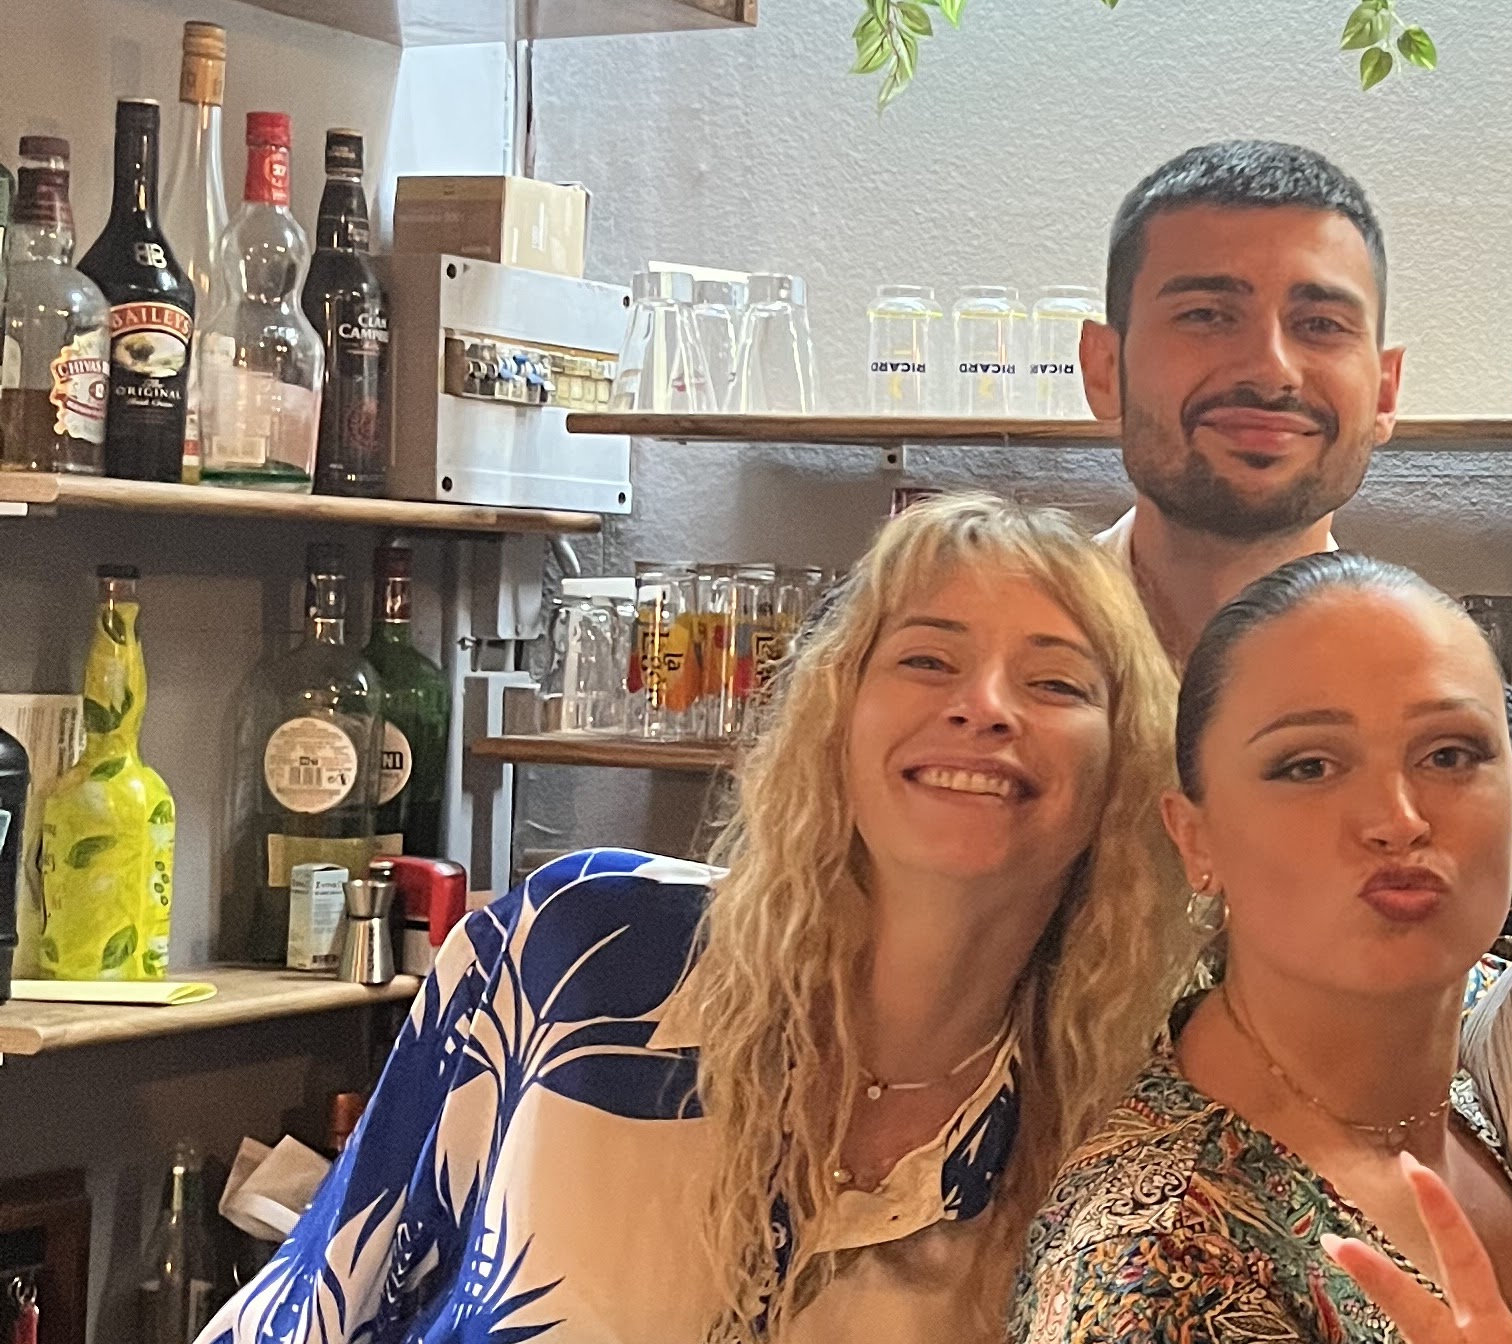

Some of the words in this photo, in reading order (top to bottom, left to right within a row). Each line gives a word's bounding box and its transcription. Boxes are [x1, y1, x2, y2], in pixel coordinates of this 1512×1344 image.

[111, 308, 191, 334] BAILEYS
[57, 360, 102, 378] CHIVAS
[870, 362, 926, 373] RICARD
[959, 362, 1016, 374] RICARD
[115, 385, 181, 400] ORIGINAL
